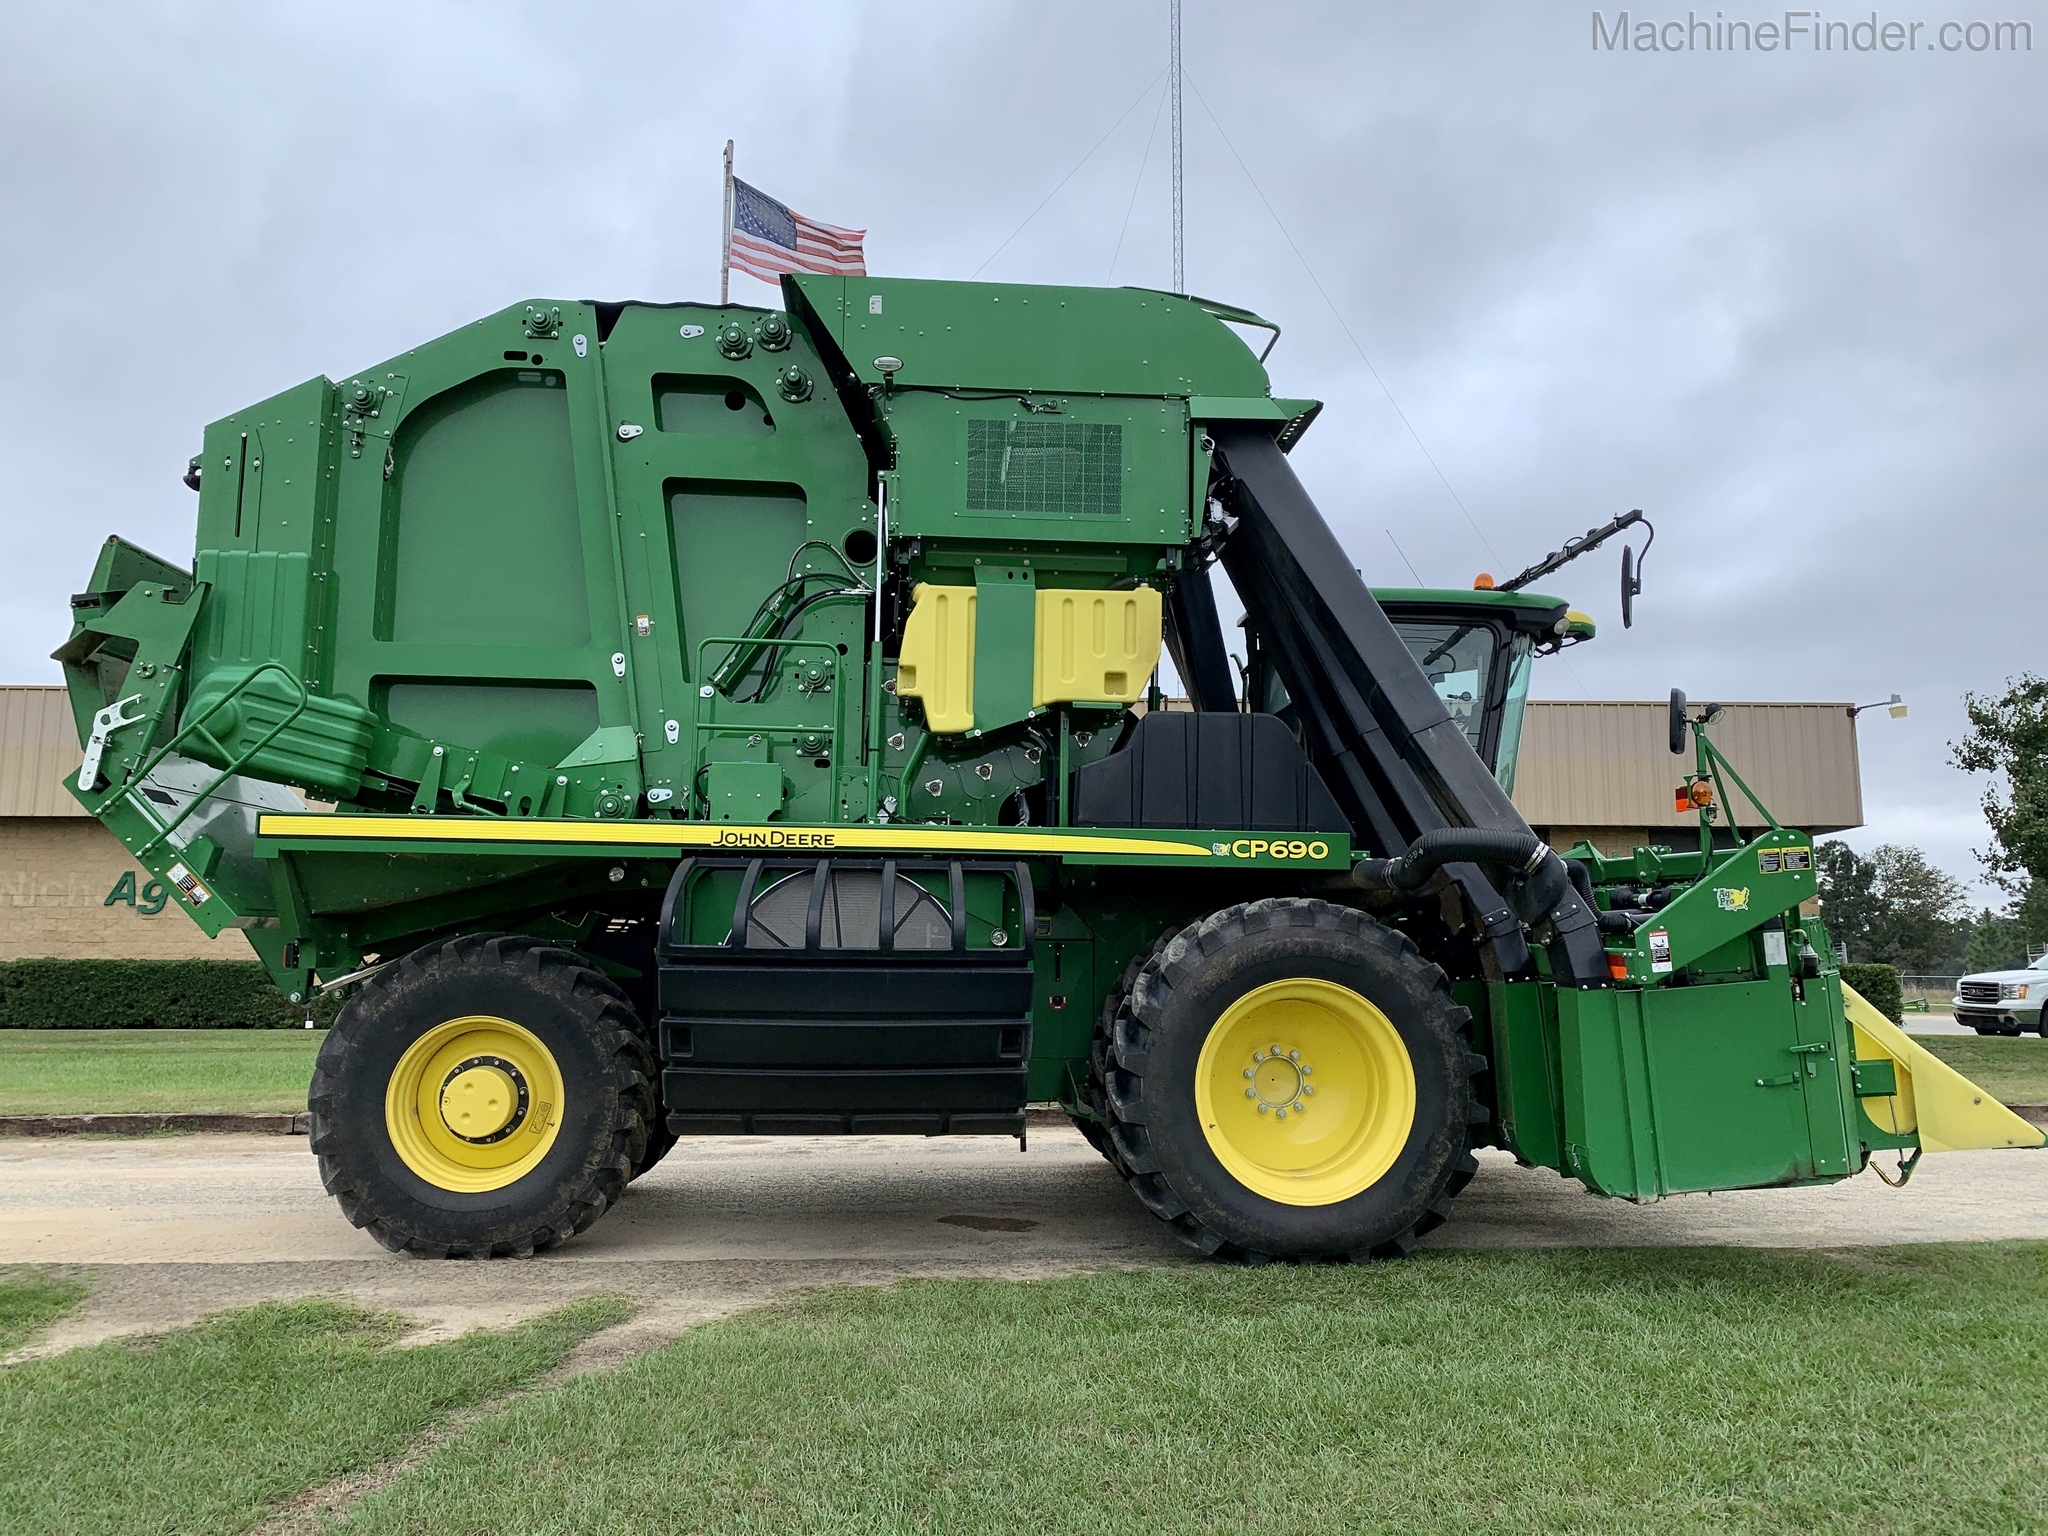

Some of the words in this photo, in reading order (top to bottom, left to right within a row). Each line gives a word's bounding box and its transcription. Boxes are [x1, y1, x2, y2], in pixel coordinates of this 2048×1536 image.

[713, 830, 766, 845] JOHN
[770, 831, 835, 846] DEERE
[1231, 839, 1329, 860] CP690
